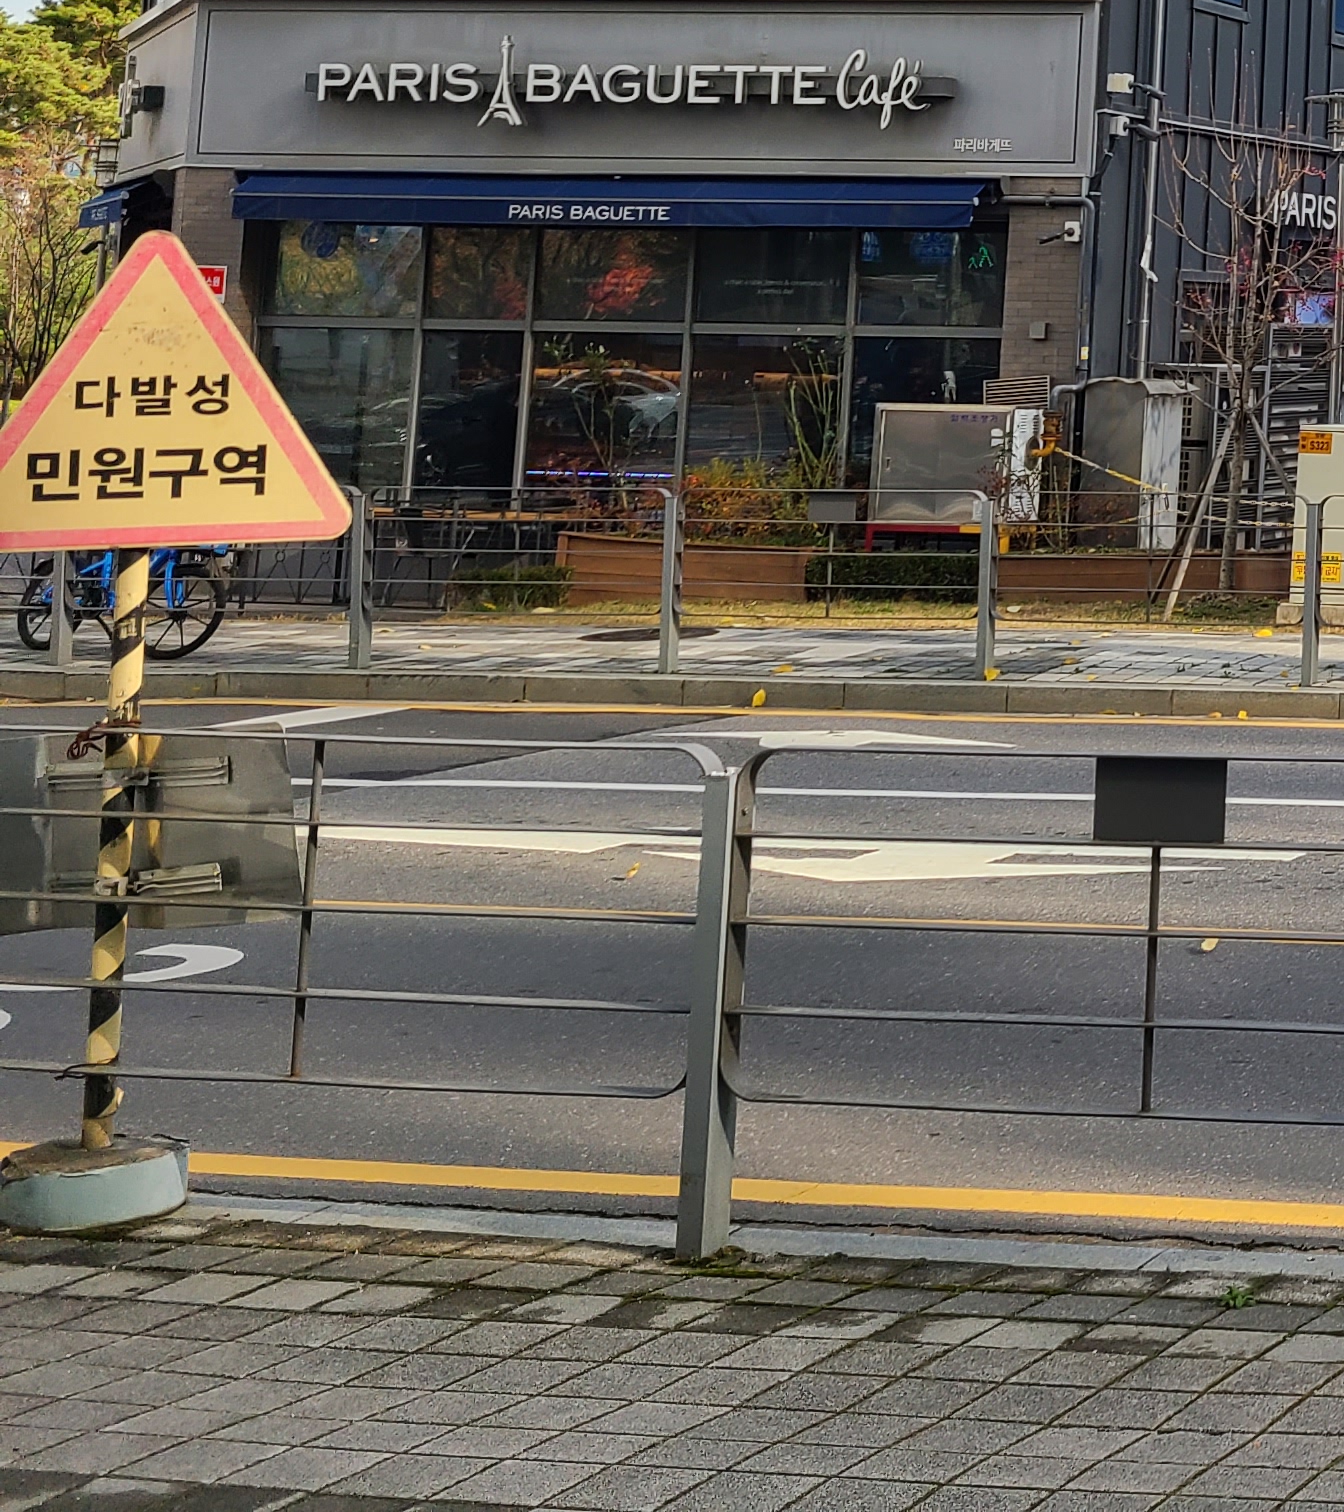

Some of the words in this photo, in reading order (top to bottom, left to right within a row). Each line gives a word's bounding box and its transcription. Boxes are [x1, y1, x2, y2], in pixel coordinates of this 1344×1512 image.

[316, 61, 479, 103] PARIS
[525, 62, 826, 106] BAGUETTE
[835, 48, 931, 130] Café
[953, 137, 1013, 153] 파리바게뜨
[507, 204, 565, 221] PARIS
[569, 204, 671, 222] BAGUETTE
[1273, 190, 1337, 230] PARIS
[74, 372, 230, 418] 다발성
[26, 443, 268, 503] 민원구역
